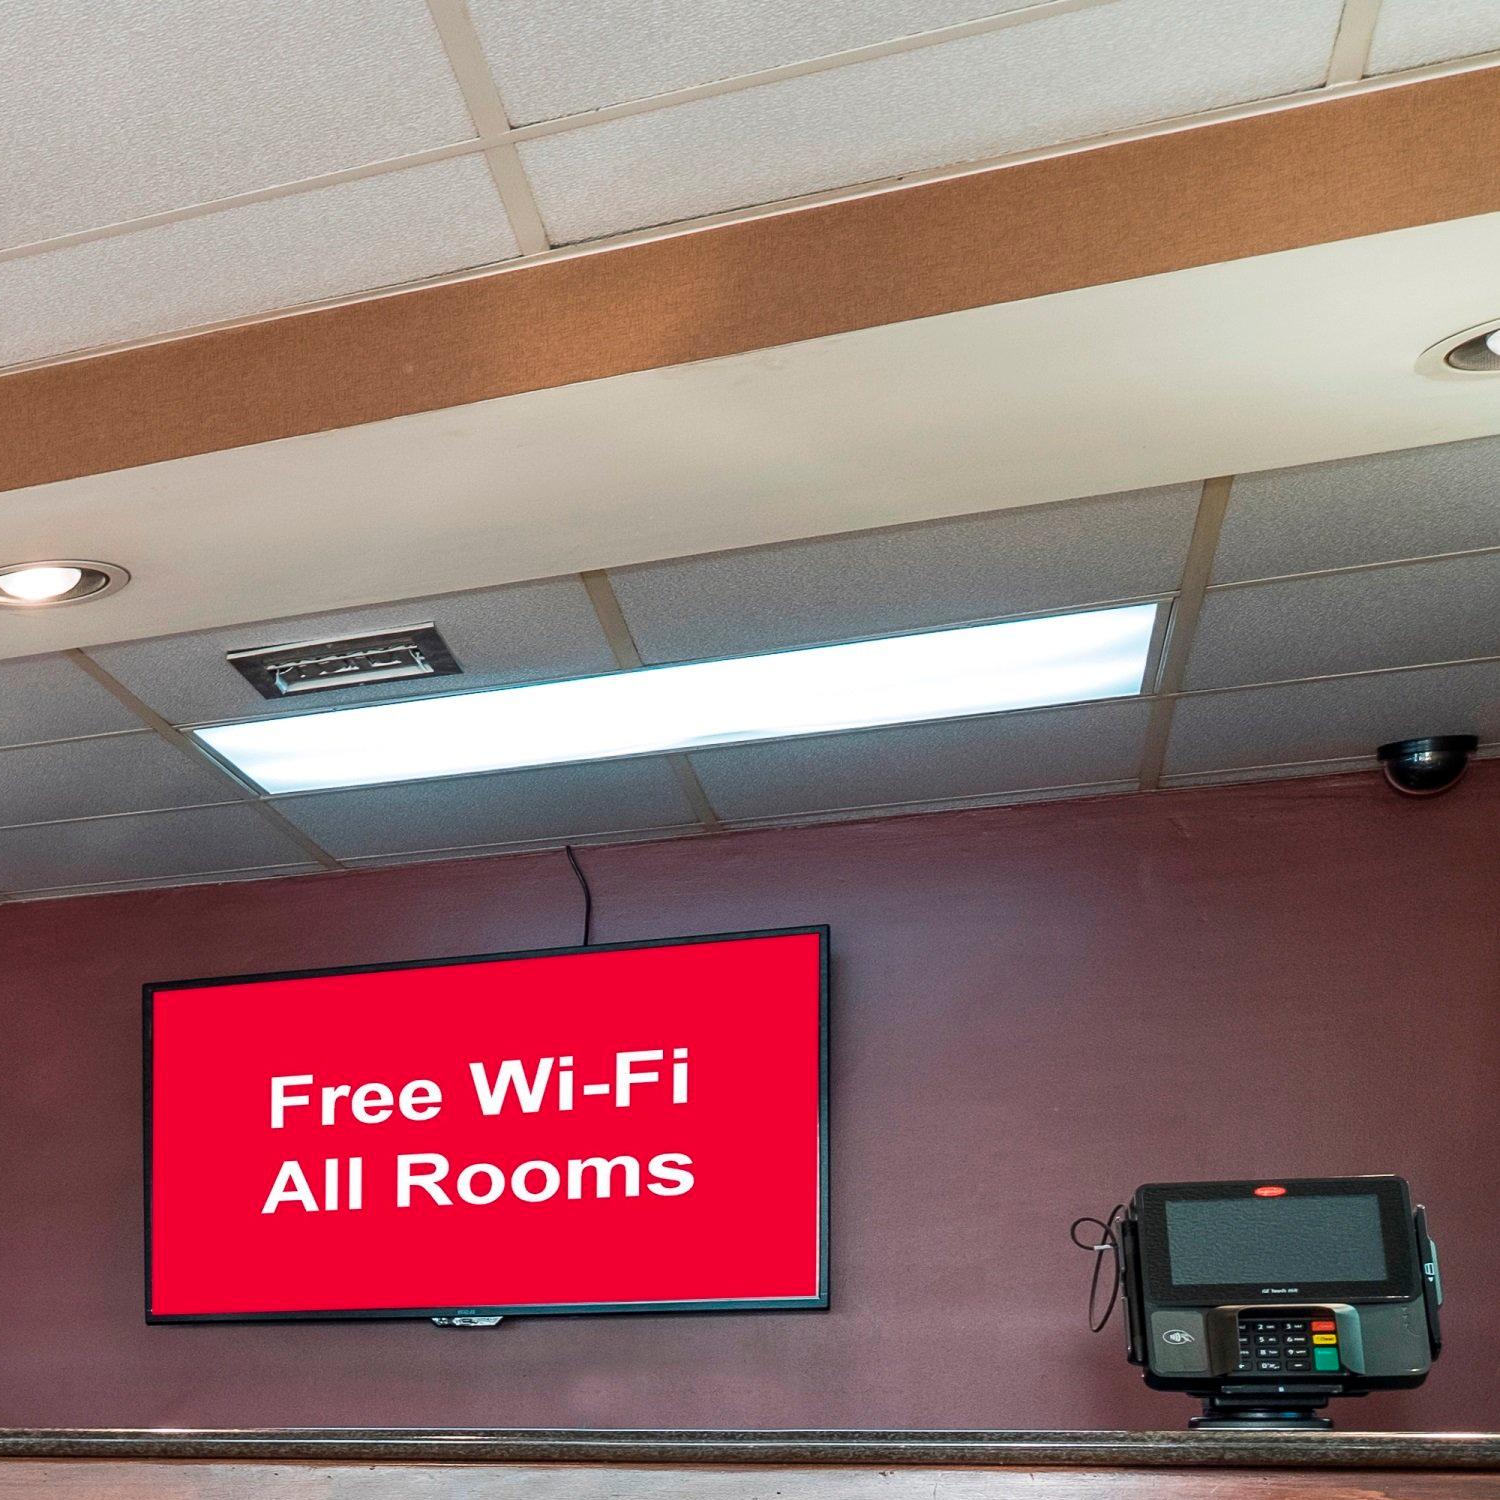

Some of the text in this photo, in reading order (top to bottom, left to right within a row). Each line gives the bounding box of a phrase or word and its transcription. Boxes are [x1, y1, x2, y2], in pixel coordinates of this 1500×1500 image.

[270, 1047, 689, 1129] Free Wi-Fi
[261, 1152, 695, 1214] All Rooms
